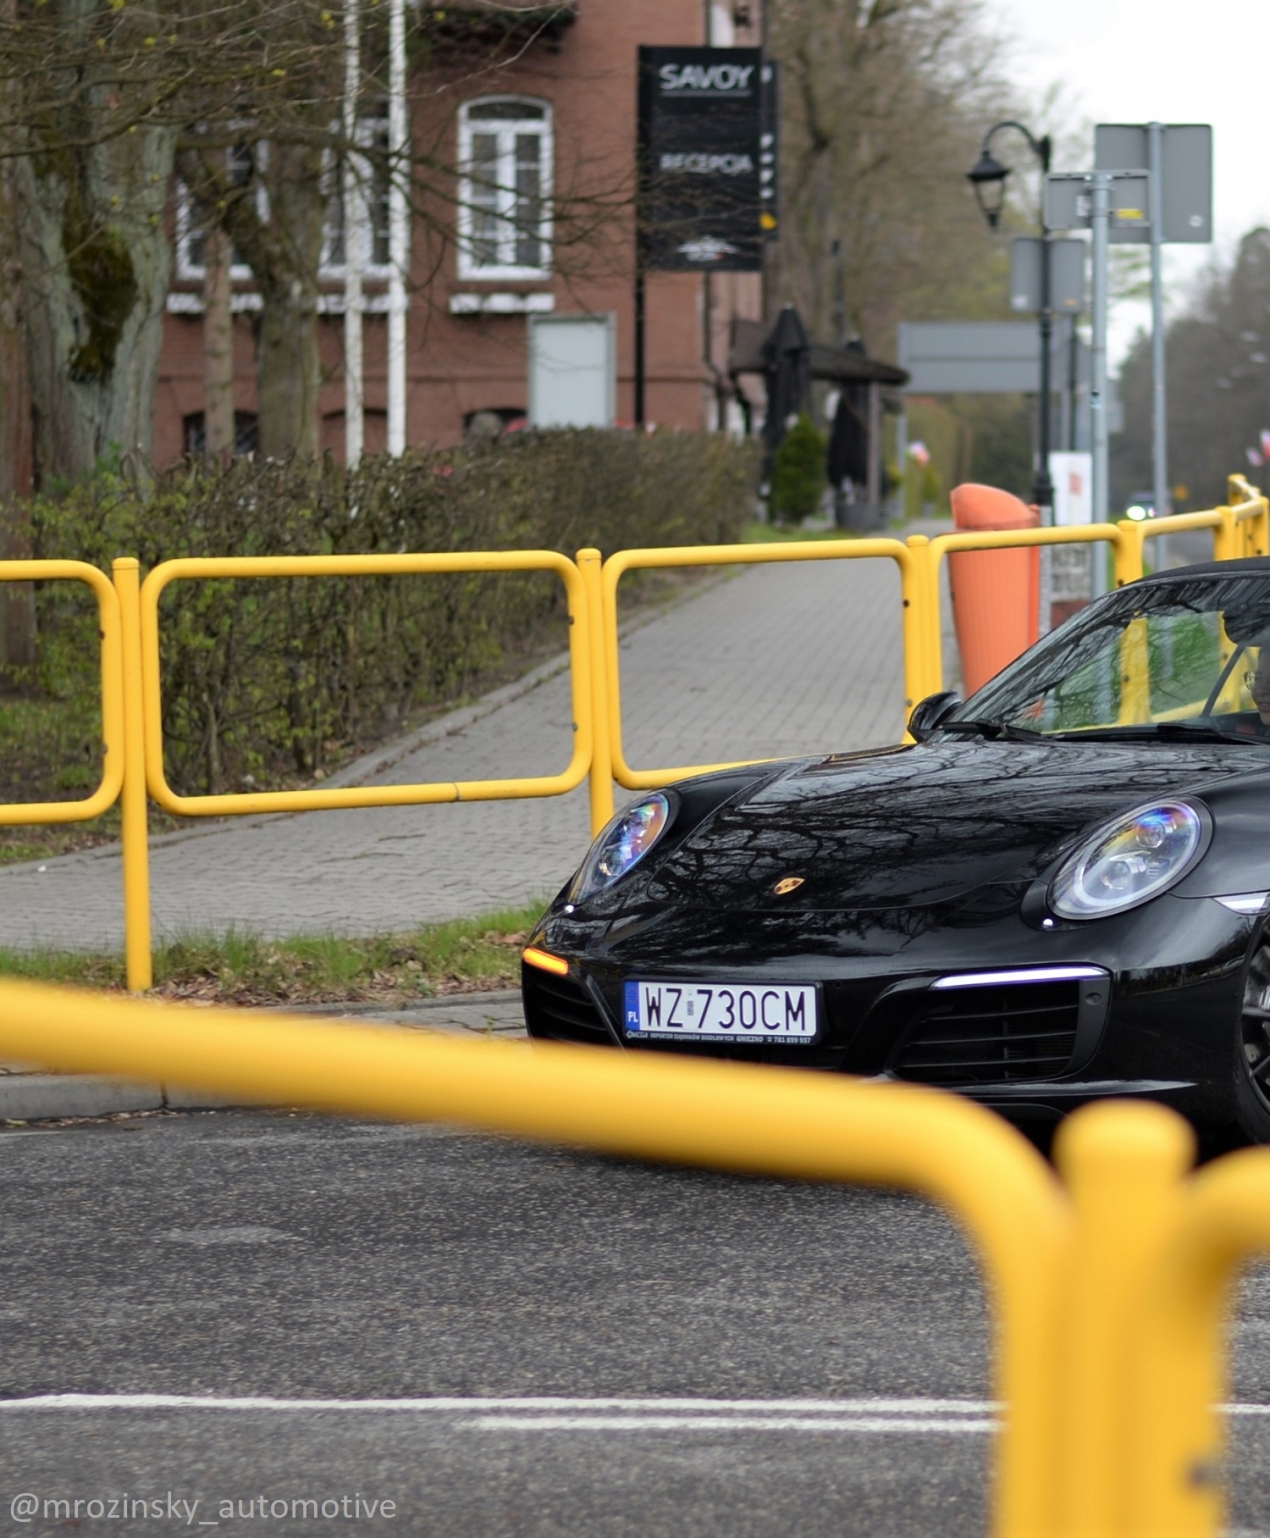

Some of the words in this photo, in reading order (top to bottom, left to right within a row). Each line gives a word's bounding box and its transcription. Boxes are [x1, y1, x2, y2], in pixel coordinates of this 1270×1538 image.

[659, 64, 754, 90] SAVOY
[628, 1011, 638, 1022] PL
[645, 987, 683, 1028] WZ
[696, 988, 806, 1032] 730CM
